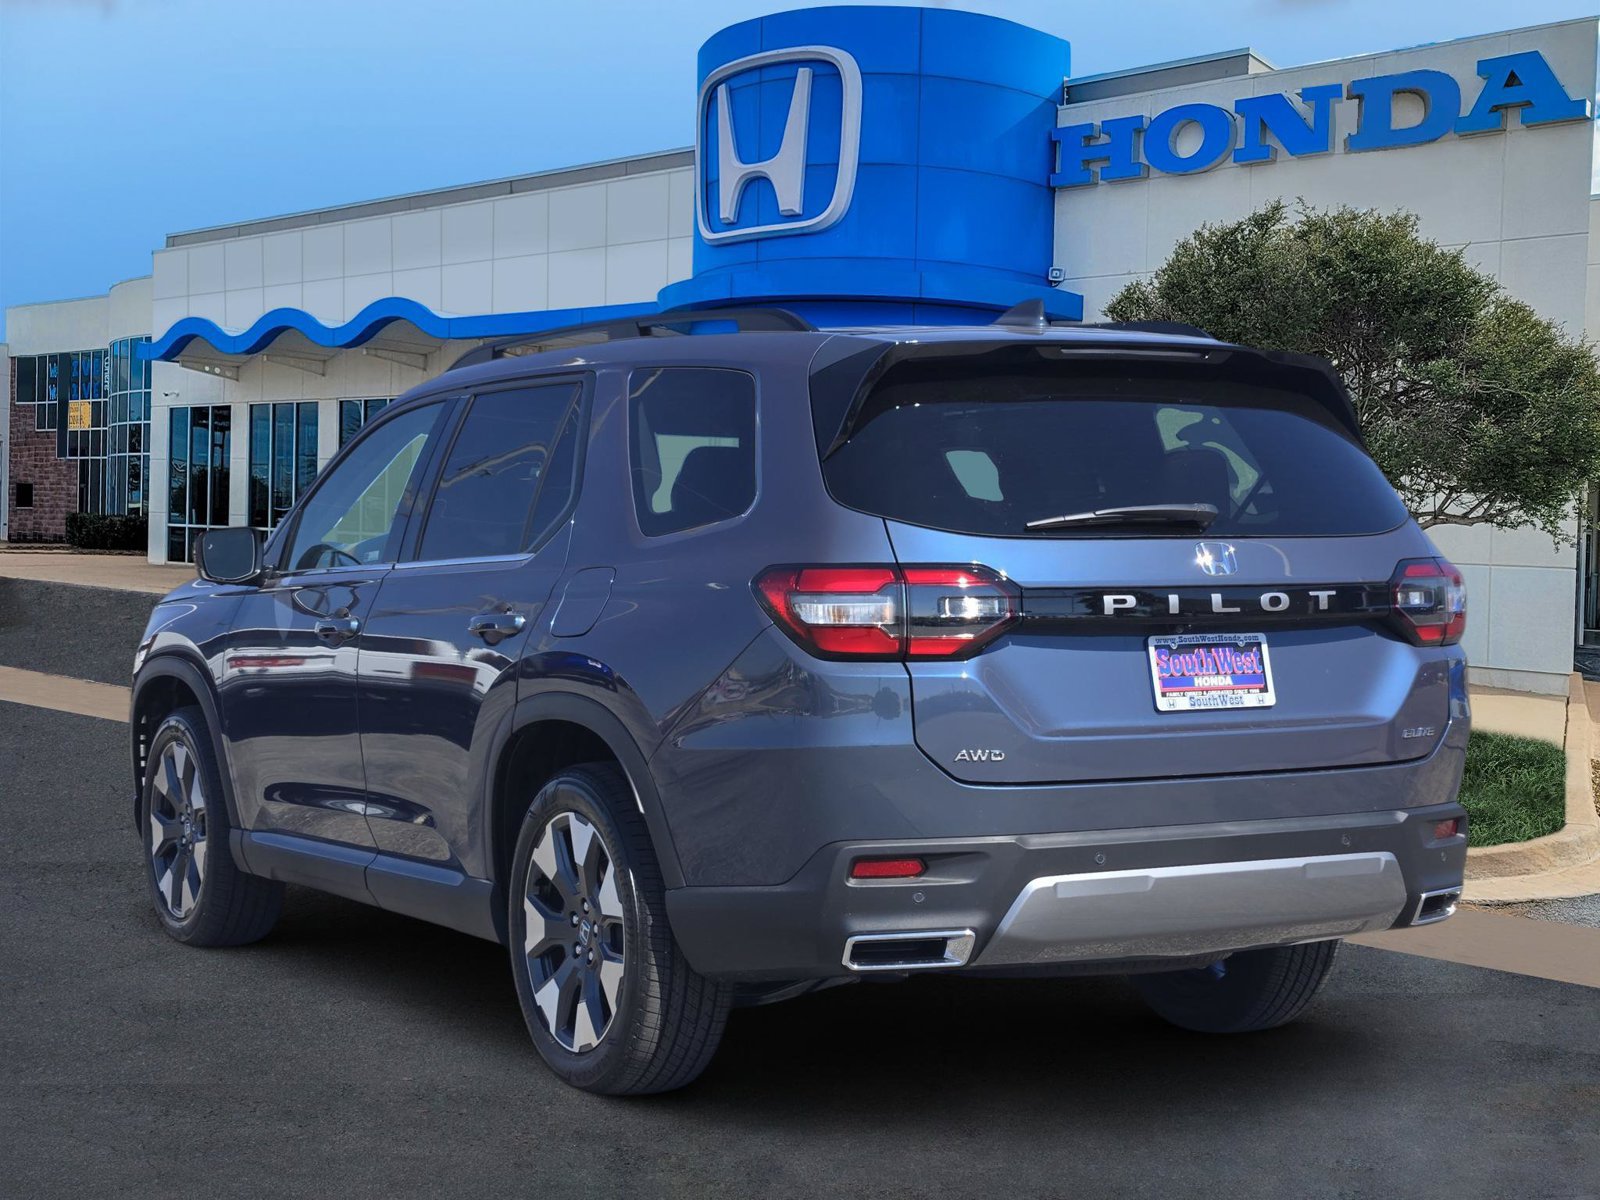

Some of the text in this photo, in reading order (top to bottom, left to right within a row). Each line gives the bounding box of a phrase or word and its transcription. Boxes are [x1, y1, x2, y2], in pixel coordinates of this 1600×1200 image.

[1050, 50, 1591, 188] HONDA
[1103, 590, 1337, 615] PILOT
[1194, 676, 1233, 687] HONDA
[1402, 727, 1435, 739] ELITE
[954, 749, 1005, 762] AWD
